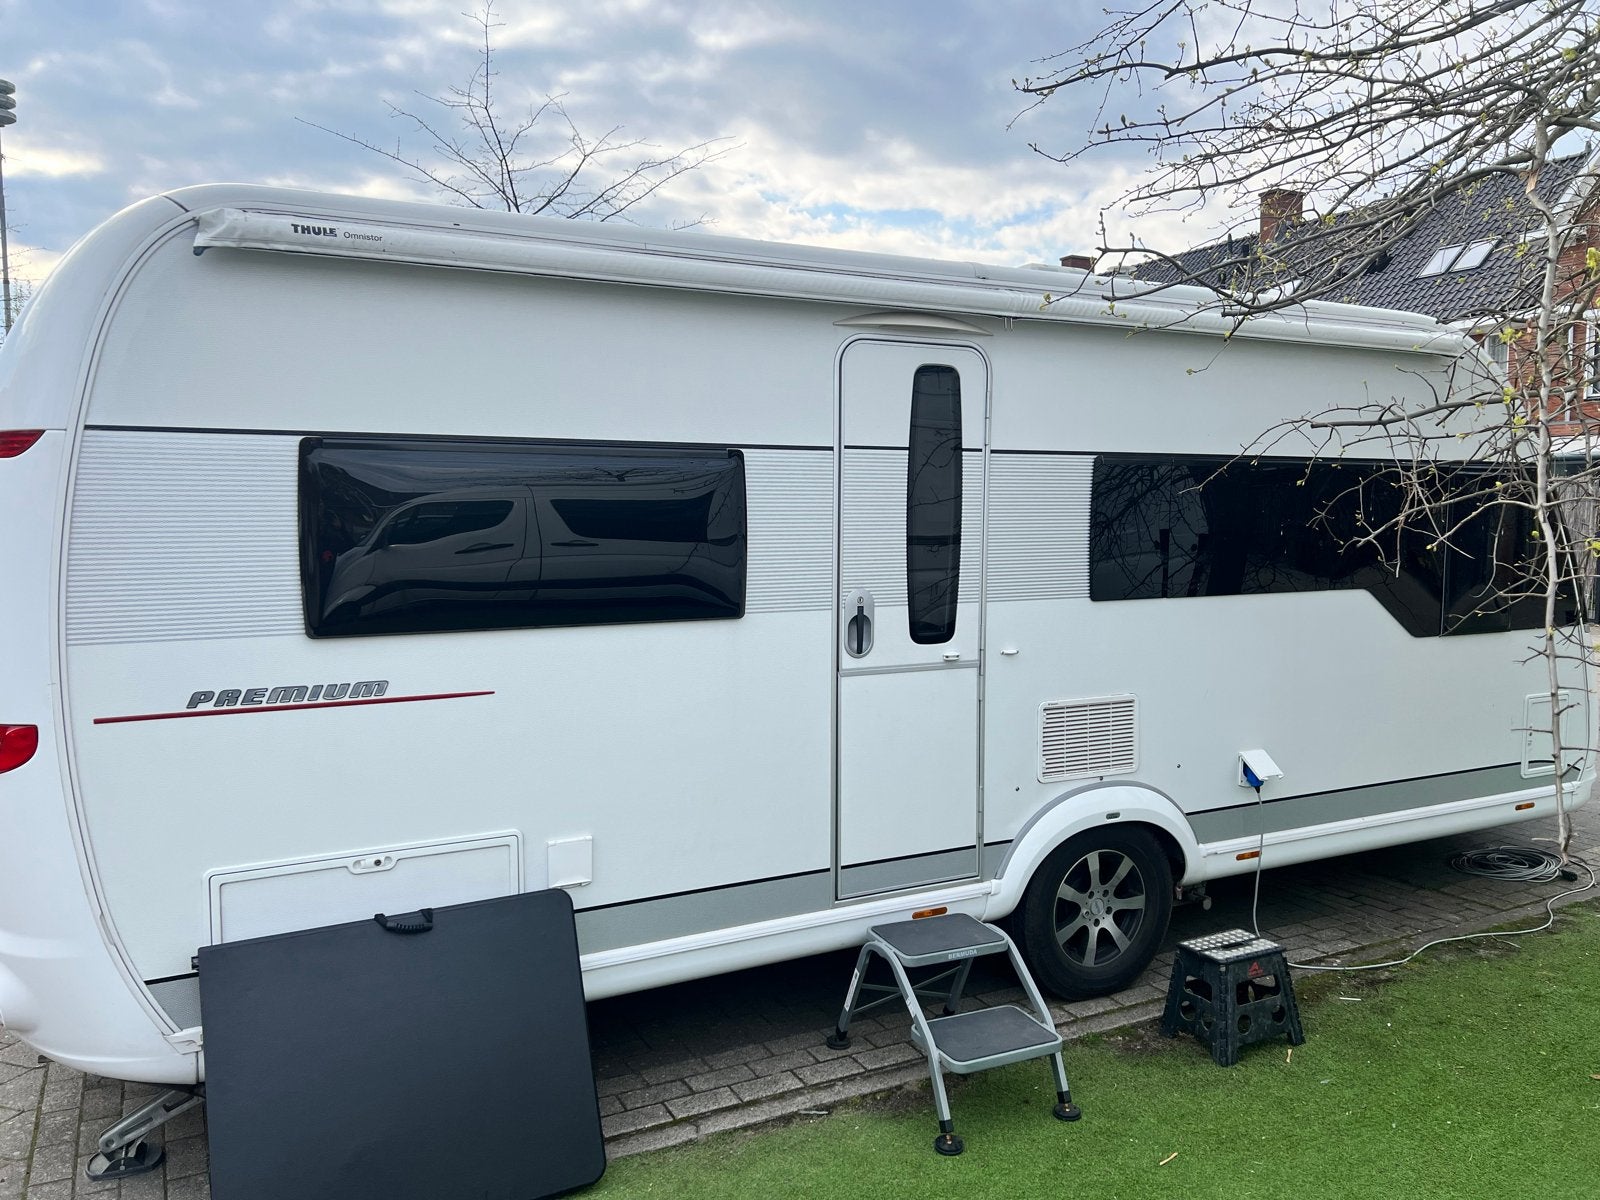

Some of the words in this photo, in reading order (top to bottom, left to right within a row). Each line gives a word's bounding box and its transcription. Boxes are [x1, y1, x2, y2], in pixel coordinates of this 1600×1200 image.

[291, 224, 337, 237] THULE
[343, 231, 383, 241] Omnistor
[186, 680, 389, 709] PREMIUM
[948, 949, 978, 960] BERMUDA
